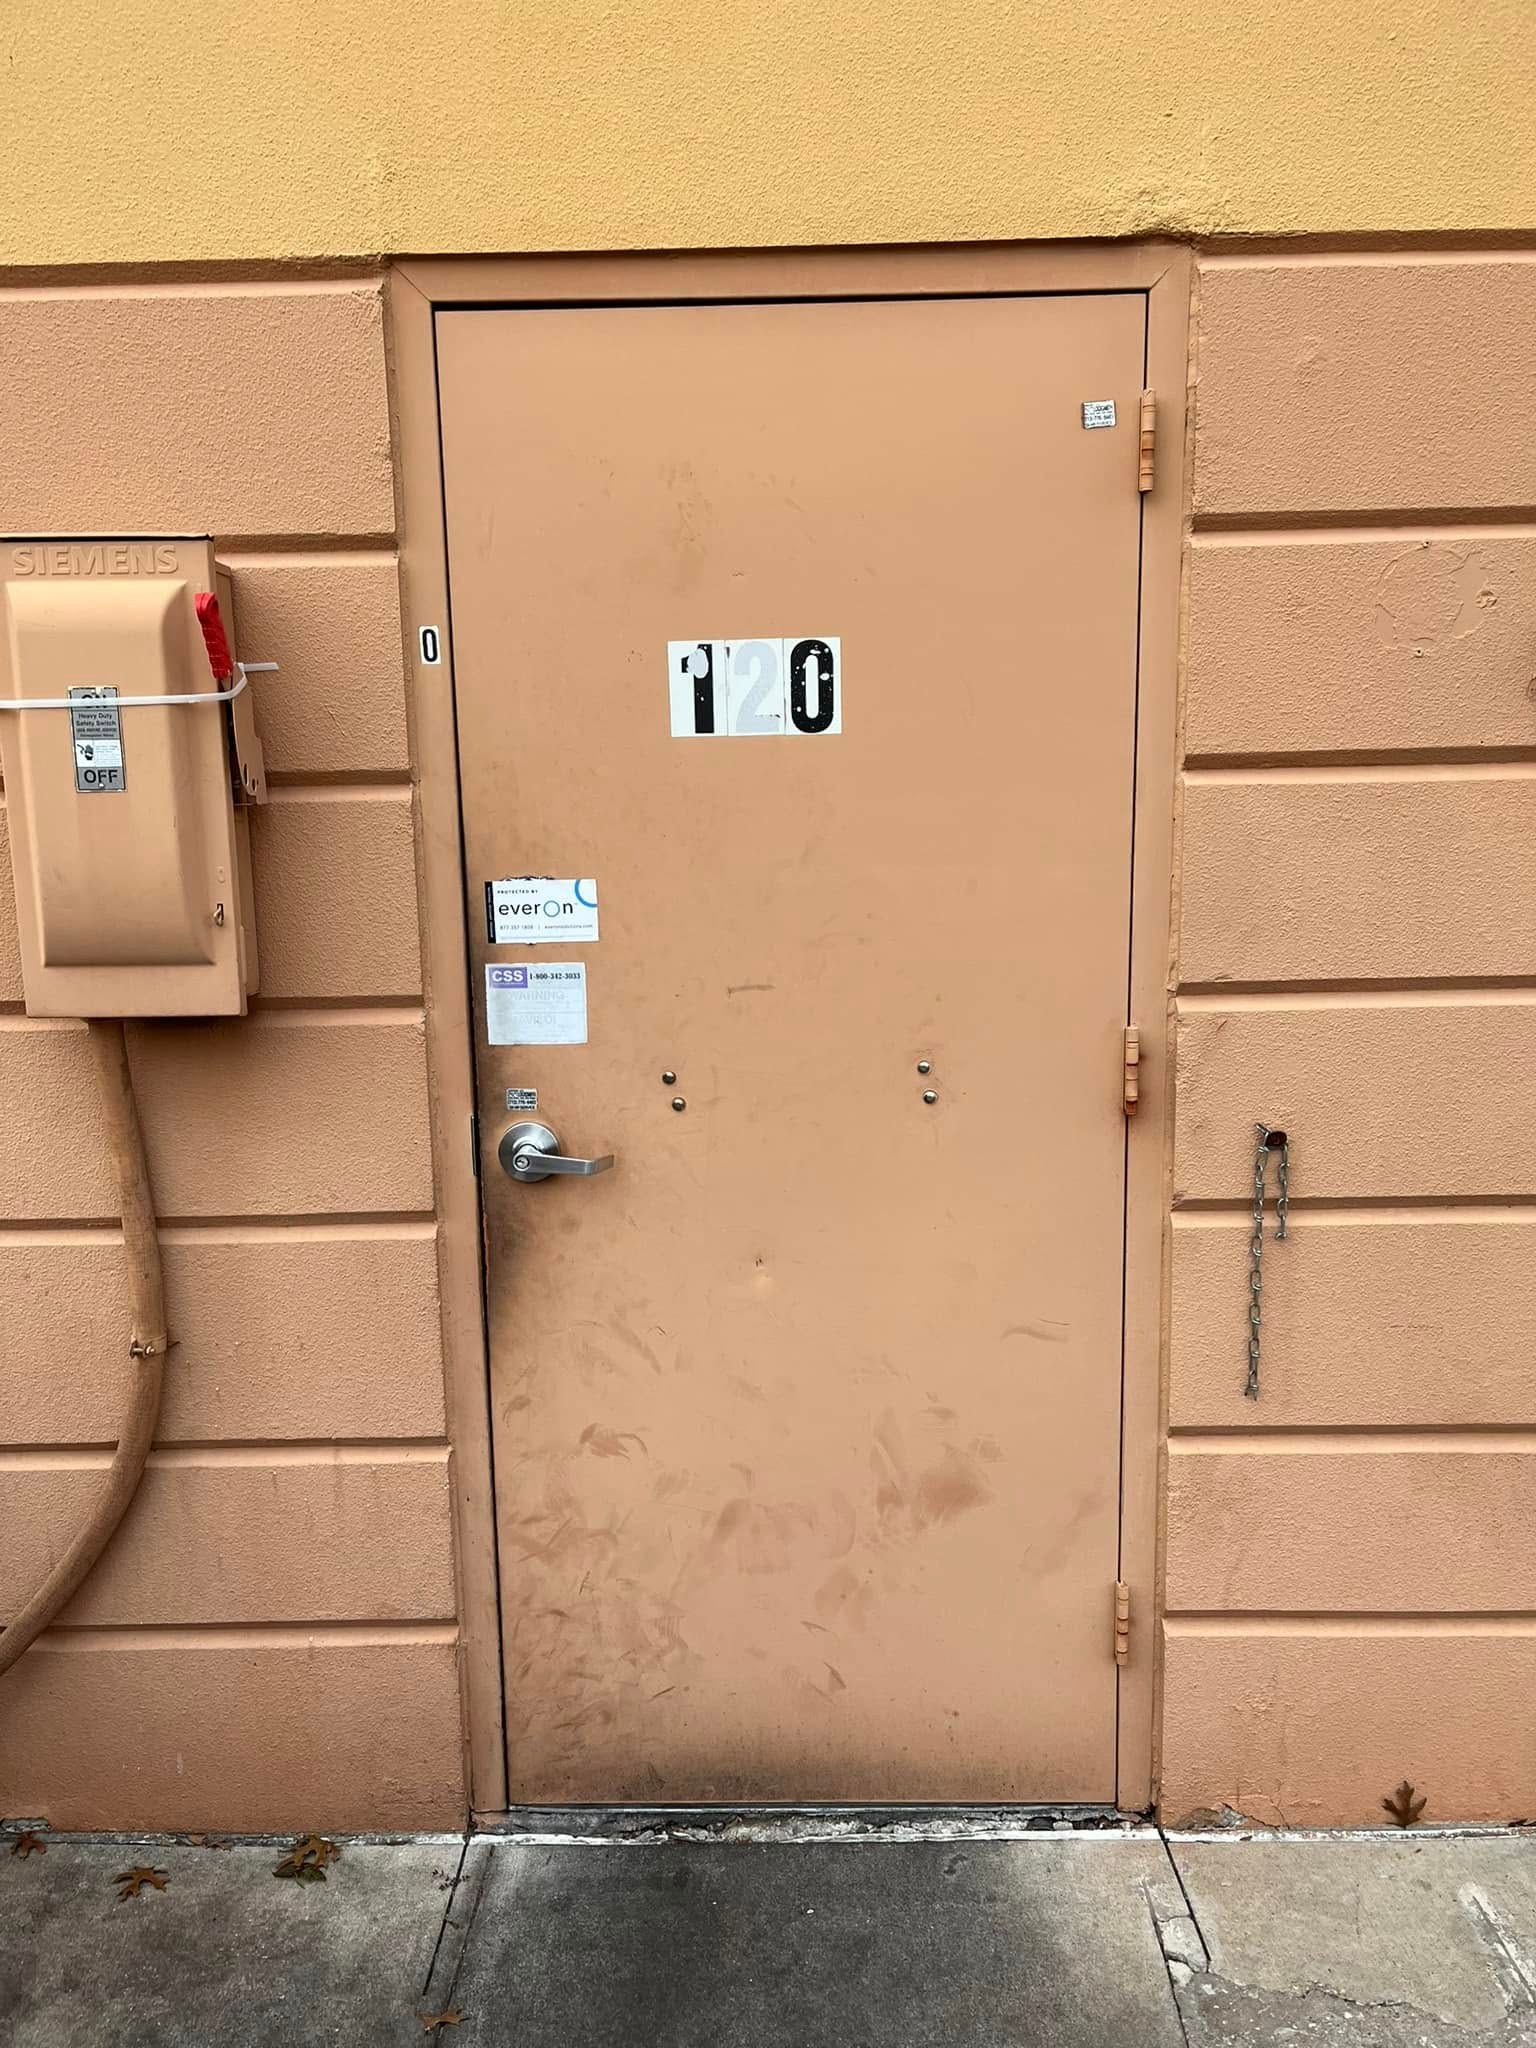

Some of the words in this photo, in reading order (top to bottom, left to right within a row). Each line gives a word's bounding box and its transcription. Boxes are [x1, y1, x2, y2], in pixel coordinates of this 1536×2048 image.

[12, 545, 179, 576] SIEMENS
[681, 640, 834, 734] 120
[98, 712, 113, 720] Duty
[84, 769, 118, 783] OFF
[492, 970, 524, 982] CSS
